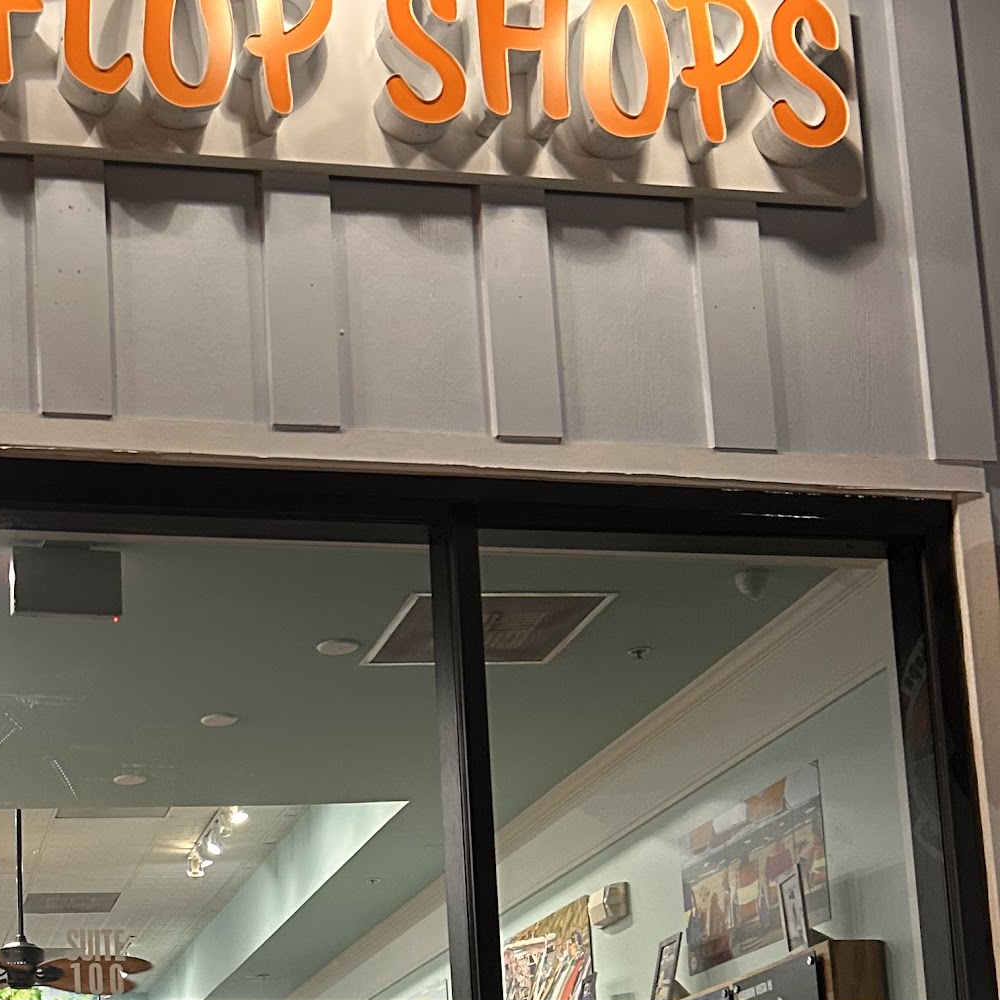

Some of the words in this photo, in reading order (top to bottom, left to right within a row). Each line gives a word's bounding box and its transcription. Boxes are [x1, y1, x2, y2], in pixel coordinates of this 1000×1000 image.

[383, 0, 850, 149] SHOPS
[66, 929, 125, 961] SUITE
[70, 963, 124, 995] 100
